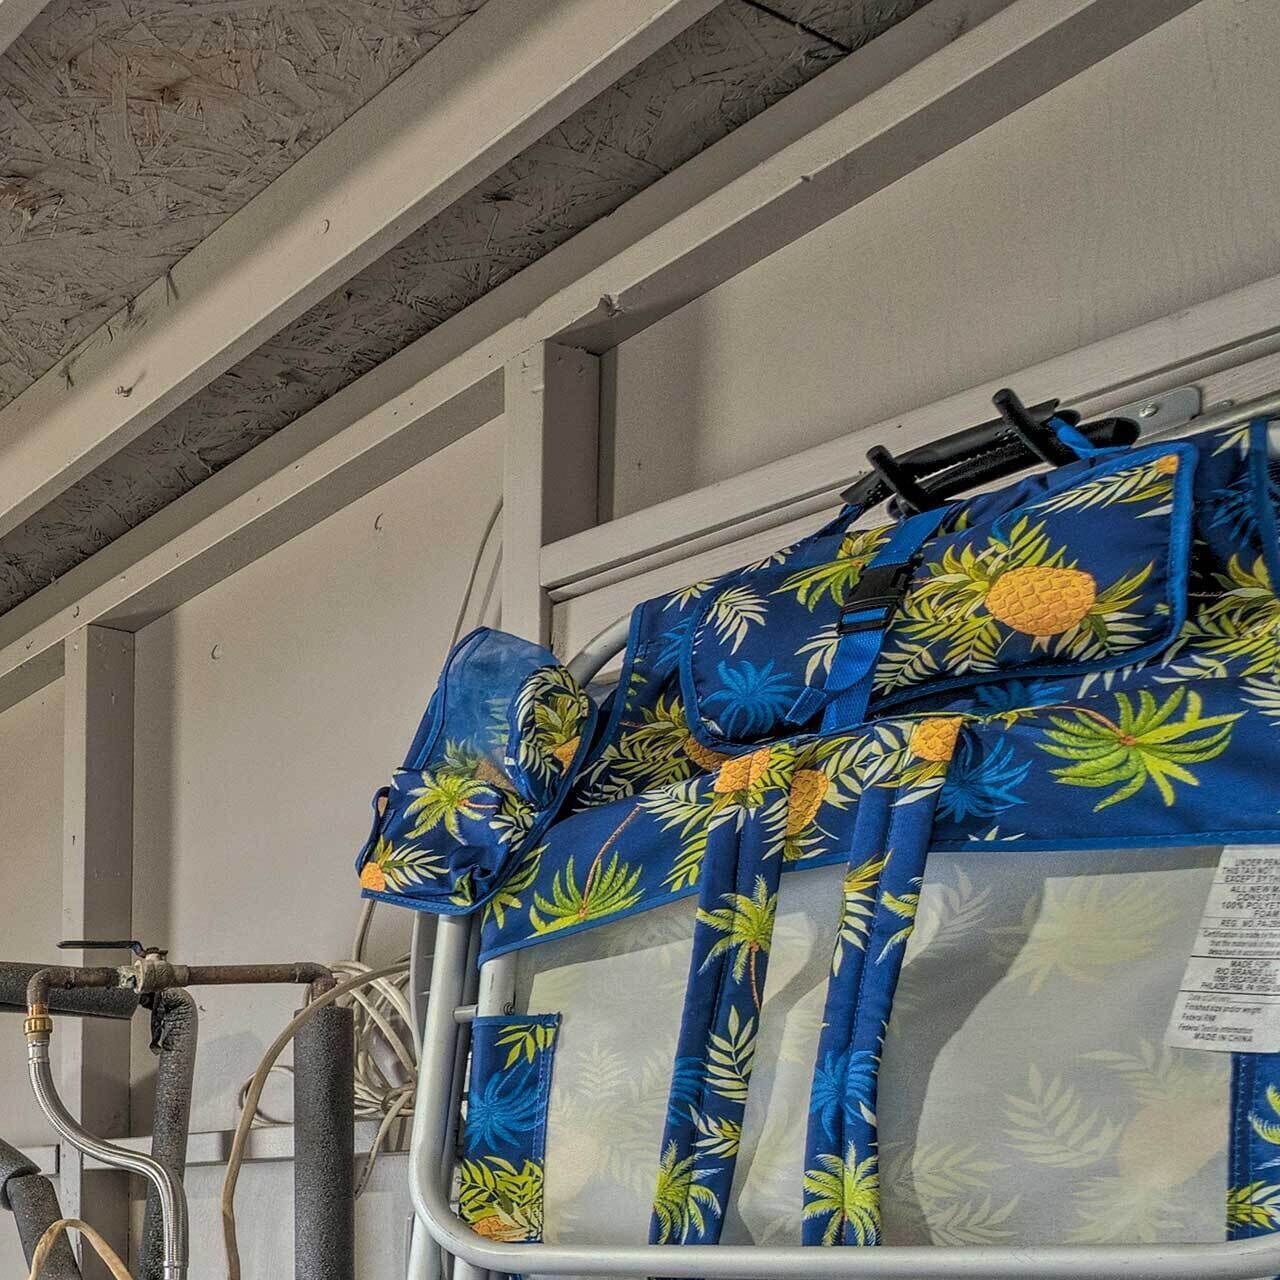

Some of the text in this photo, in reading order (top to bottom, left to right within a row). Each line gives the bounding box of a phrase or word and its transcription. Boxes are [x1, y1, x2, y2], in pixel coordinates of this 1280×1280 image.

[1235, 858, 1256, 866] UNDER
[1222, 901, 1244, 909] 100%
[1230, 968, 1263, 976] BRANDS
[1185, 1002, 1210, 1010] Finished
[1182, 1013, 1201, 1021] Federal
[1193, 1033, 1217, 1041] MADE
[1228, 1034, 1253, 1042] CHINA
